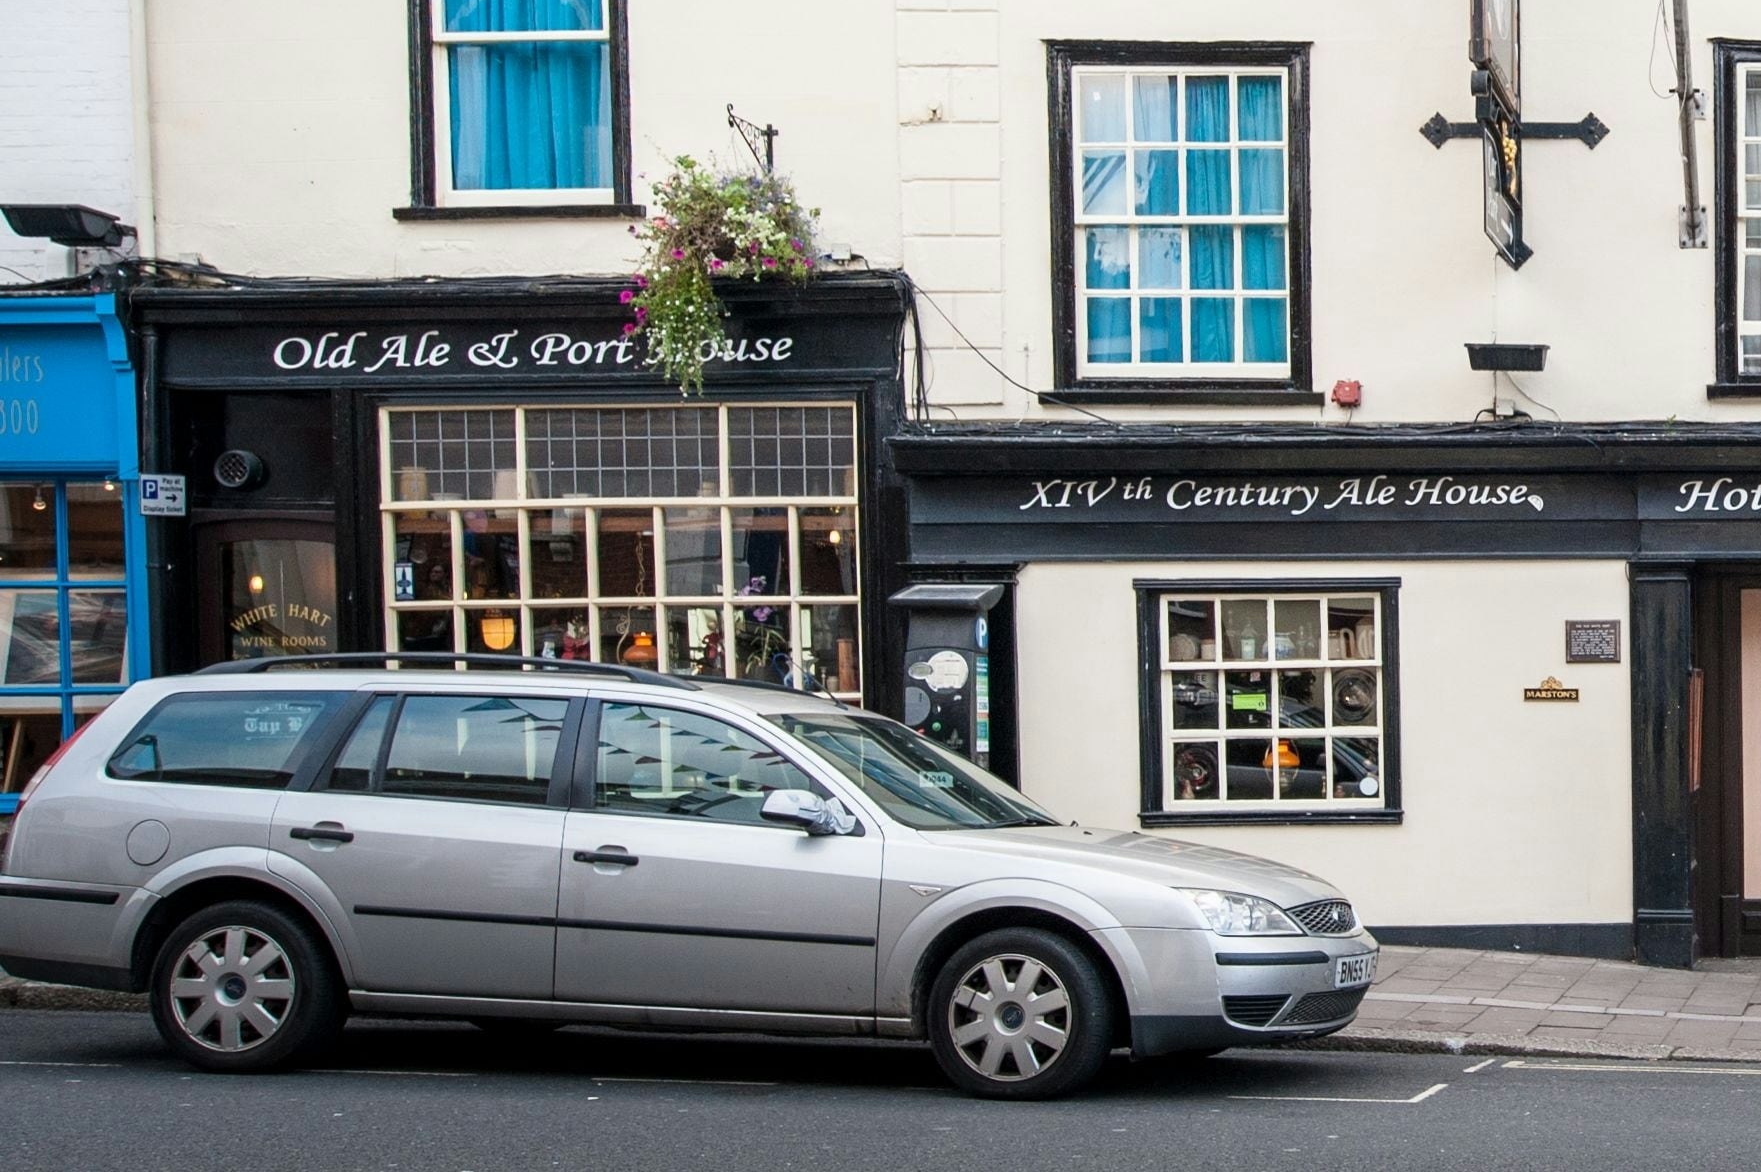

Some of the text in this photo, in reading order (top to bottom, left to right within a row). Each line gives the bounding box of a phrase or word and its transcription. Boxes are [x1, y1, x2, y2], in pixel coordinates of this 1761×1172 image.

[0, 346, 44, 382] lers
[273, 329, 793, 373] Old Ale & Port ouse
[146, 481, 156, 498] P
[1166, 479, 1319, 516] Century
[1323, 475, 1396, 510] Ale
[1405, 476, 1528, 506] House
[230, 603, 332, 632] WHITE HART
[240, 635, 327, 647] WINE ROOMS
[1526, 690, 1577, 699] MARSTON'S
